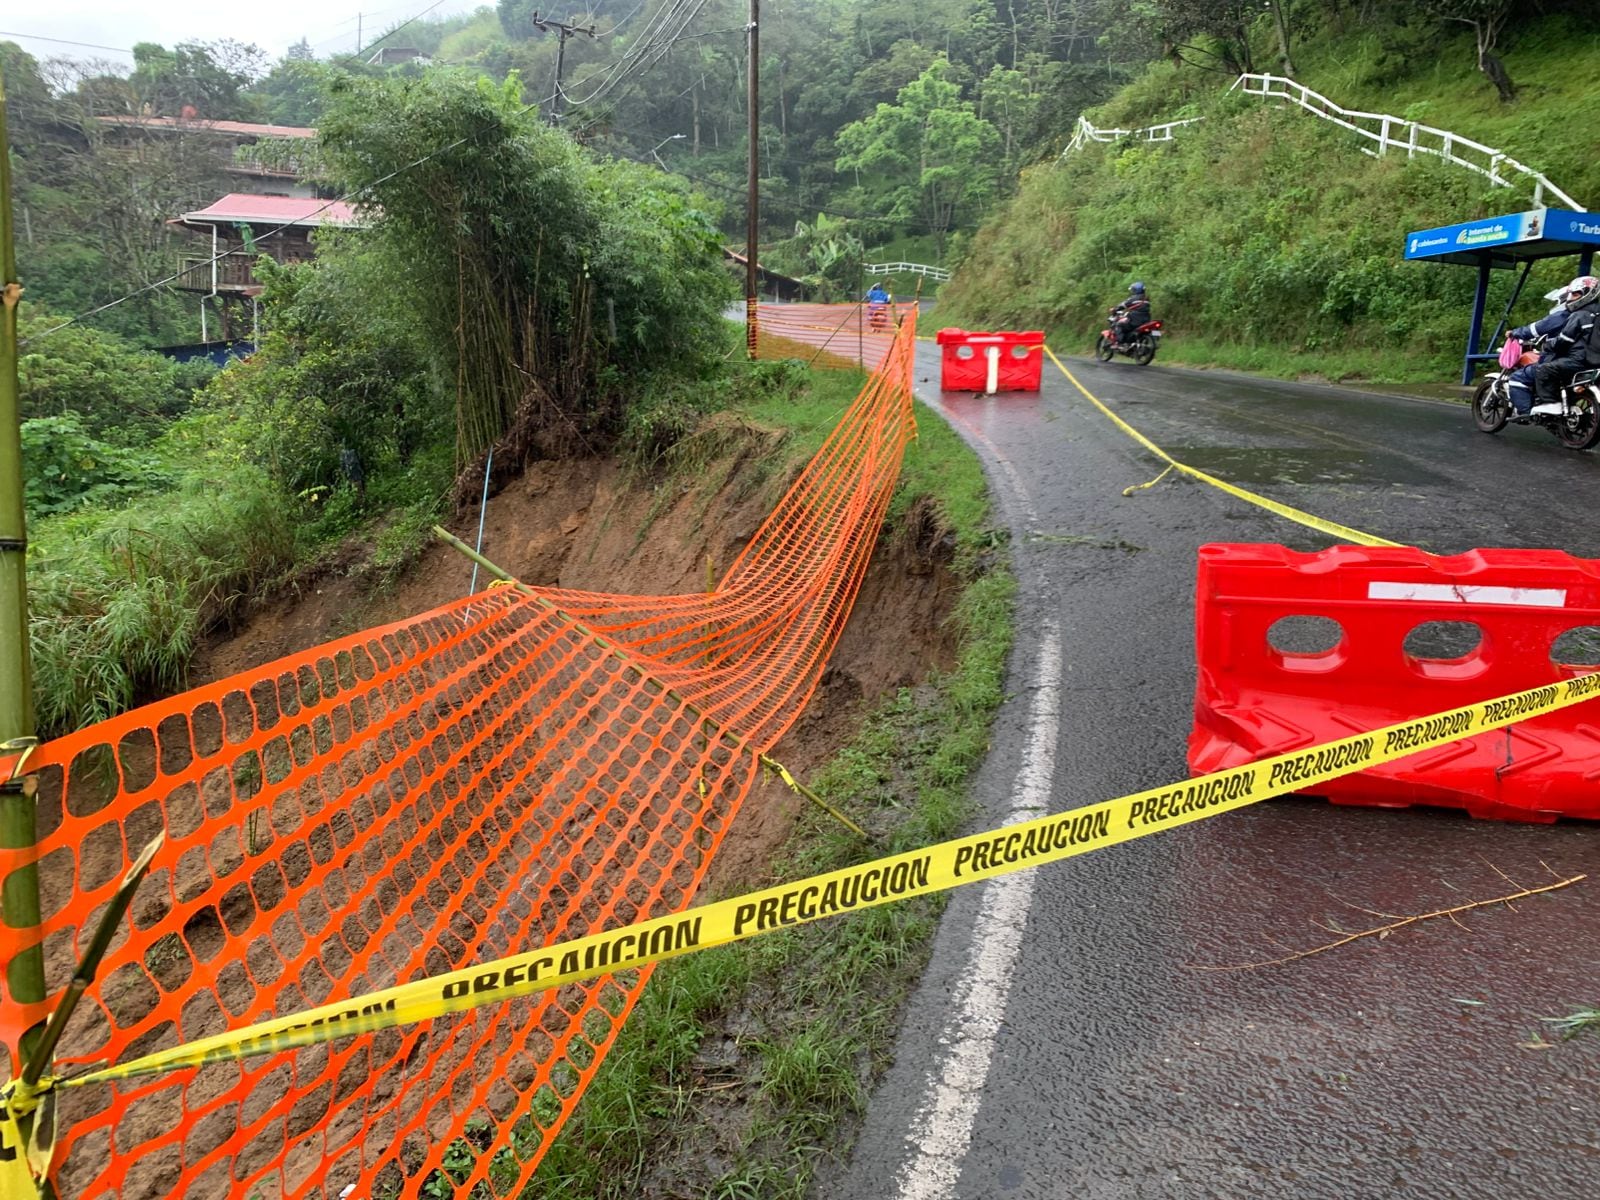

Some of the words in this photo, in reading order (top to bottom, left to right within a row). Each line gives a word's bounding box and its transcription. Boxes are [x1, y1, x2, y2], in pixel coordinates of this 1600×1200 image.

[733, 856, 931, 936] PRECAUCION
[953, 809, 1111, 877] PRECAUCION
[1127, 770, 1255, 829] PRECAUCION
[1268, 737, 1373, 788] PRECAUCION
[1384, 709, 1474, 754] PRECAUCION
[1481, 685, 1558, 726] PRECAUCION
